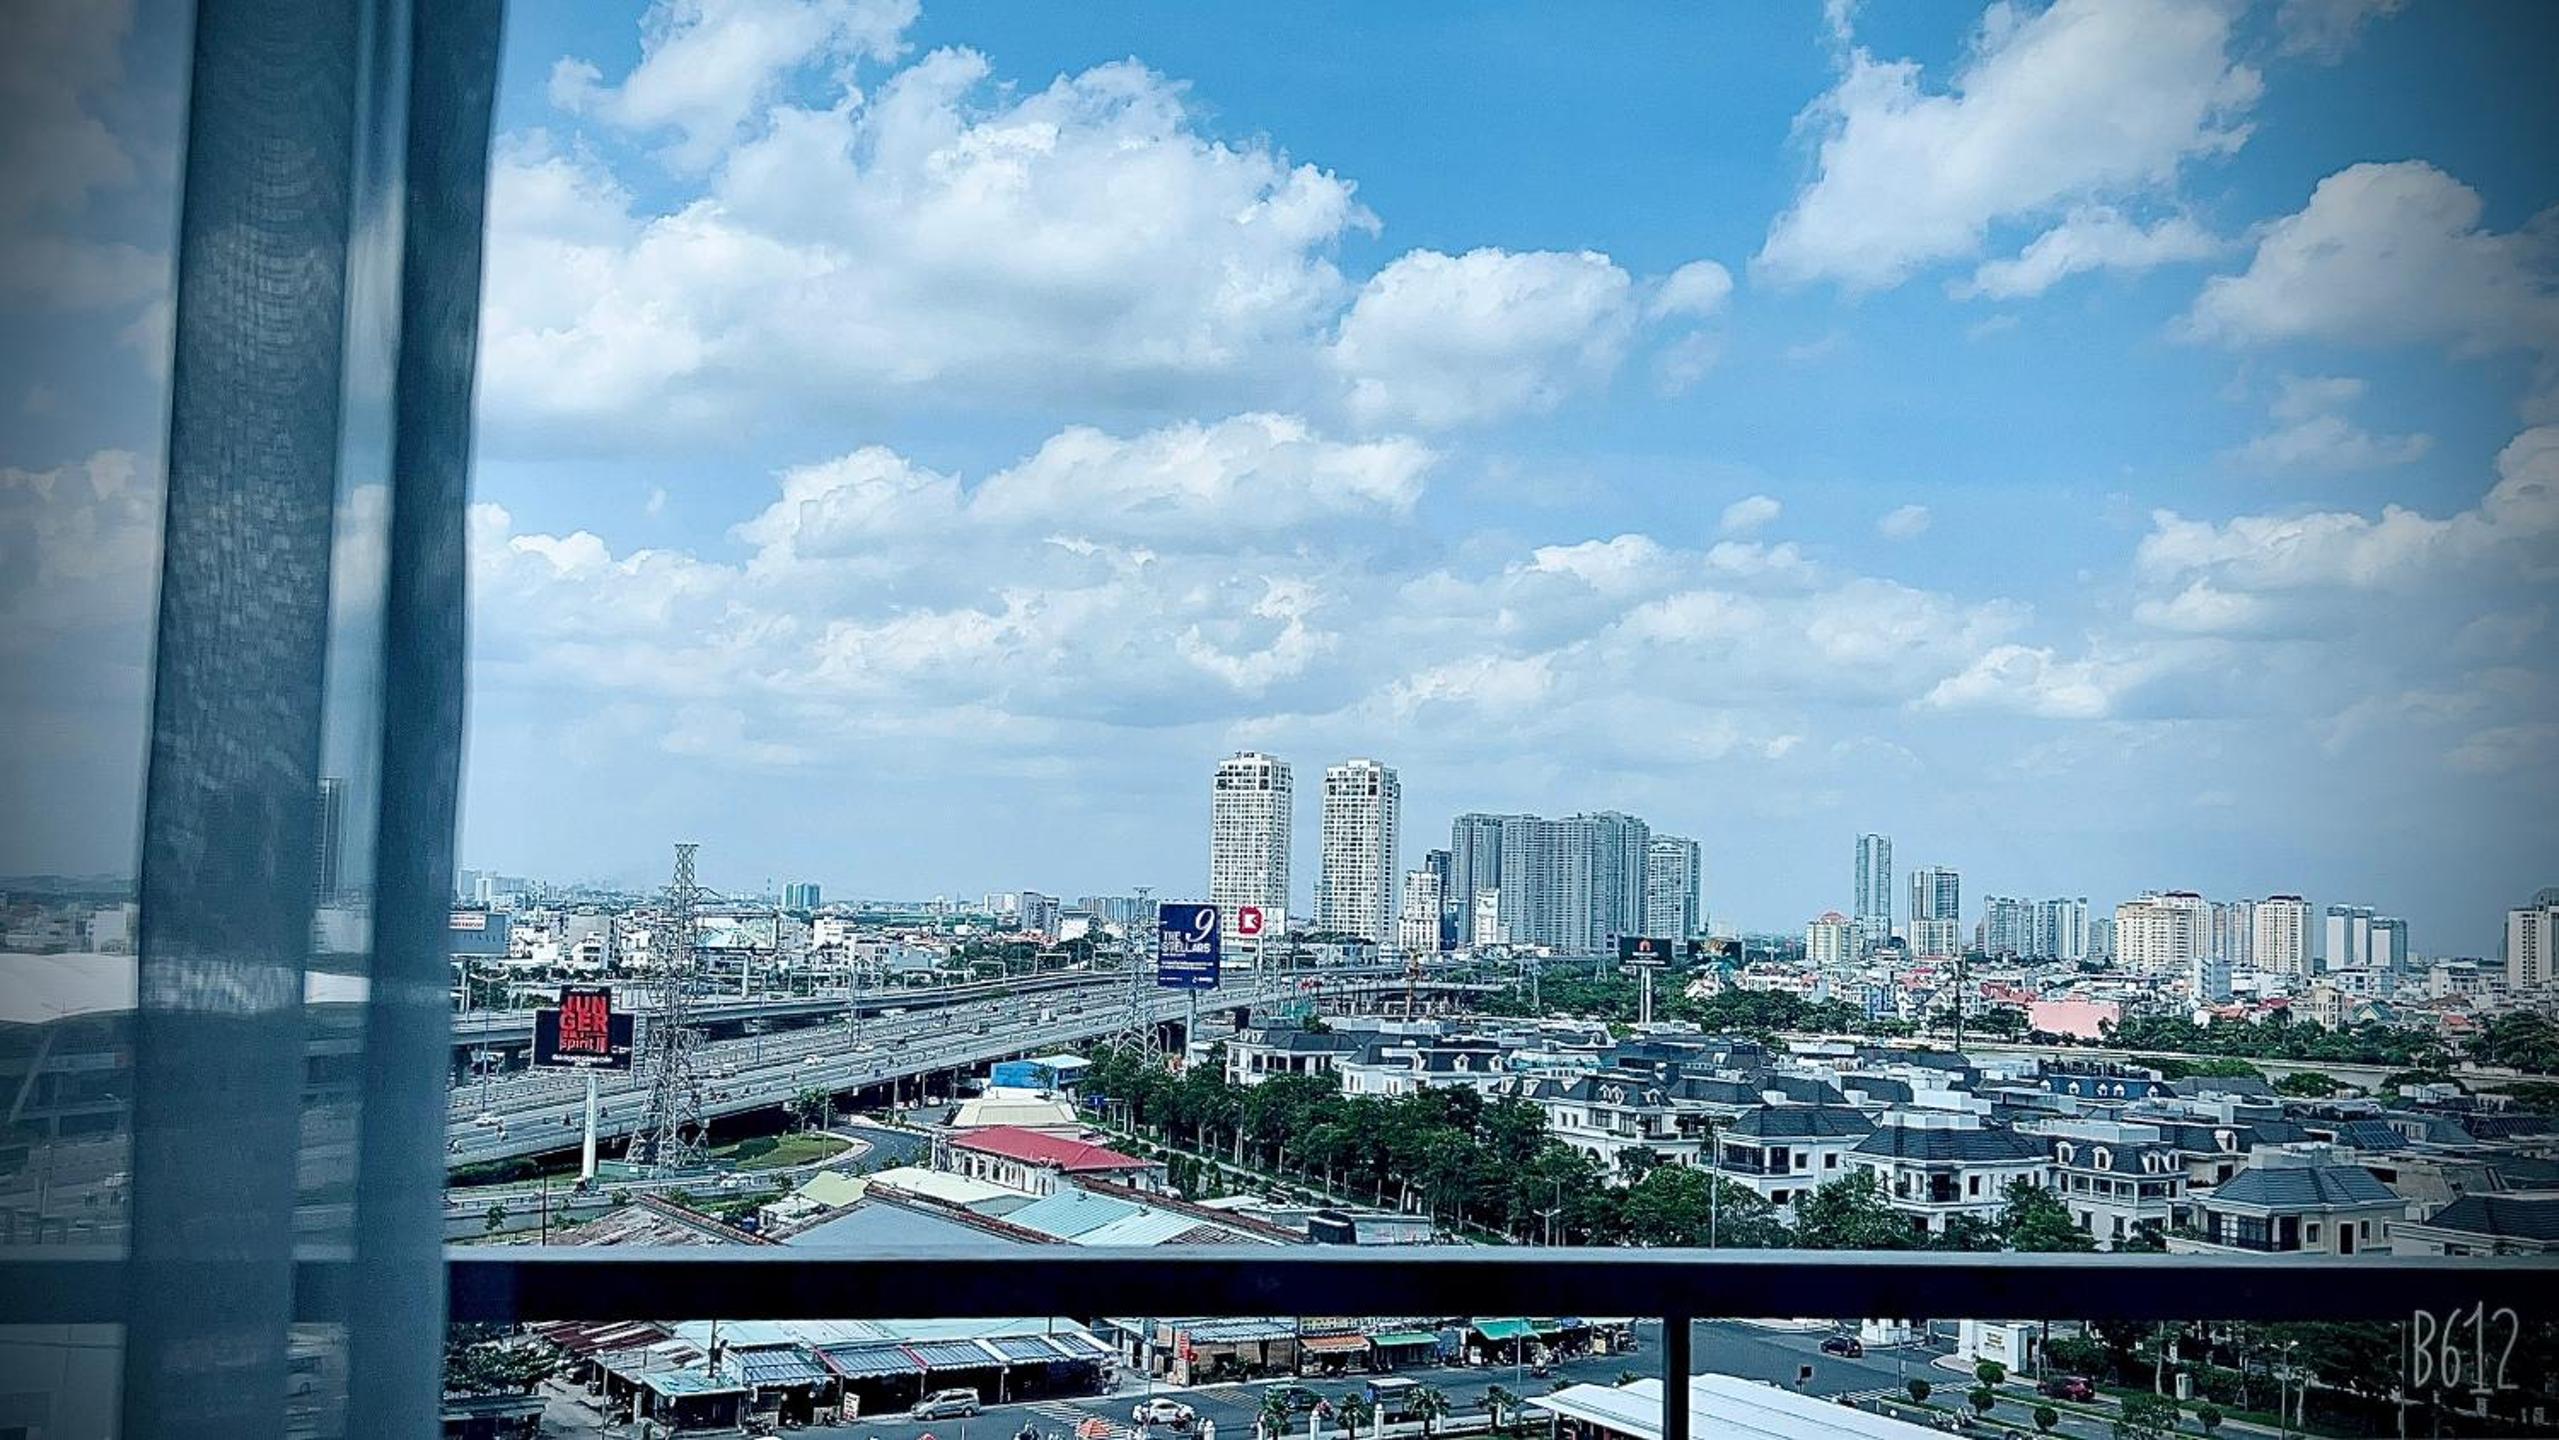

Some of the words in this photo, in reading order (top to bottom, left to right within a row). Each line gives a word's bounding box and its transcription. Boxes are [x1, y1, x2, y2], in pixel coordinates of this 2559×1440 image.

[1185, 908, 1215, 942] 9
[1163, 931, 1181, 941] THE
[1161, 941, 1212, 953] STELLARS
